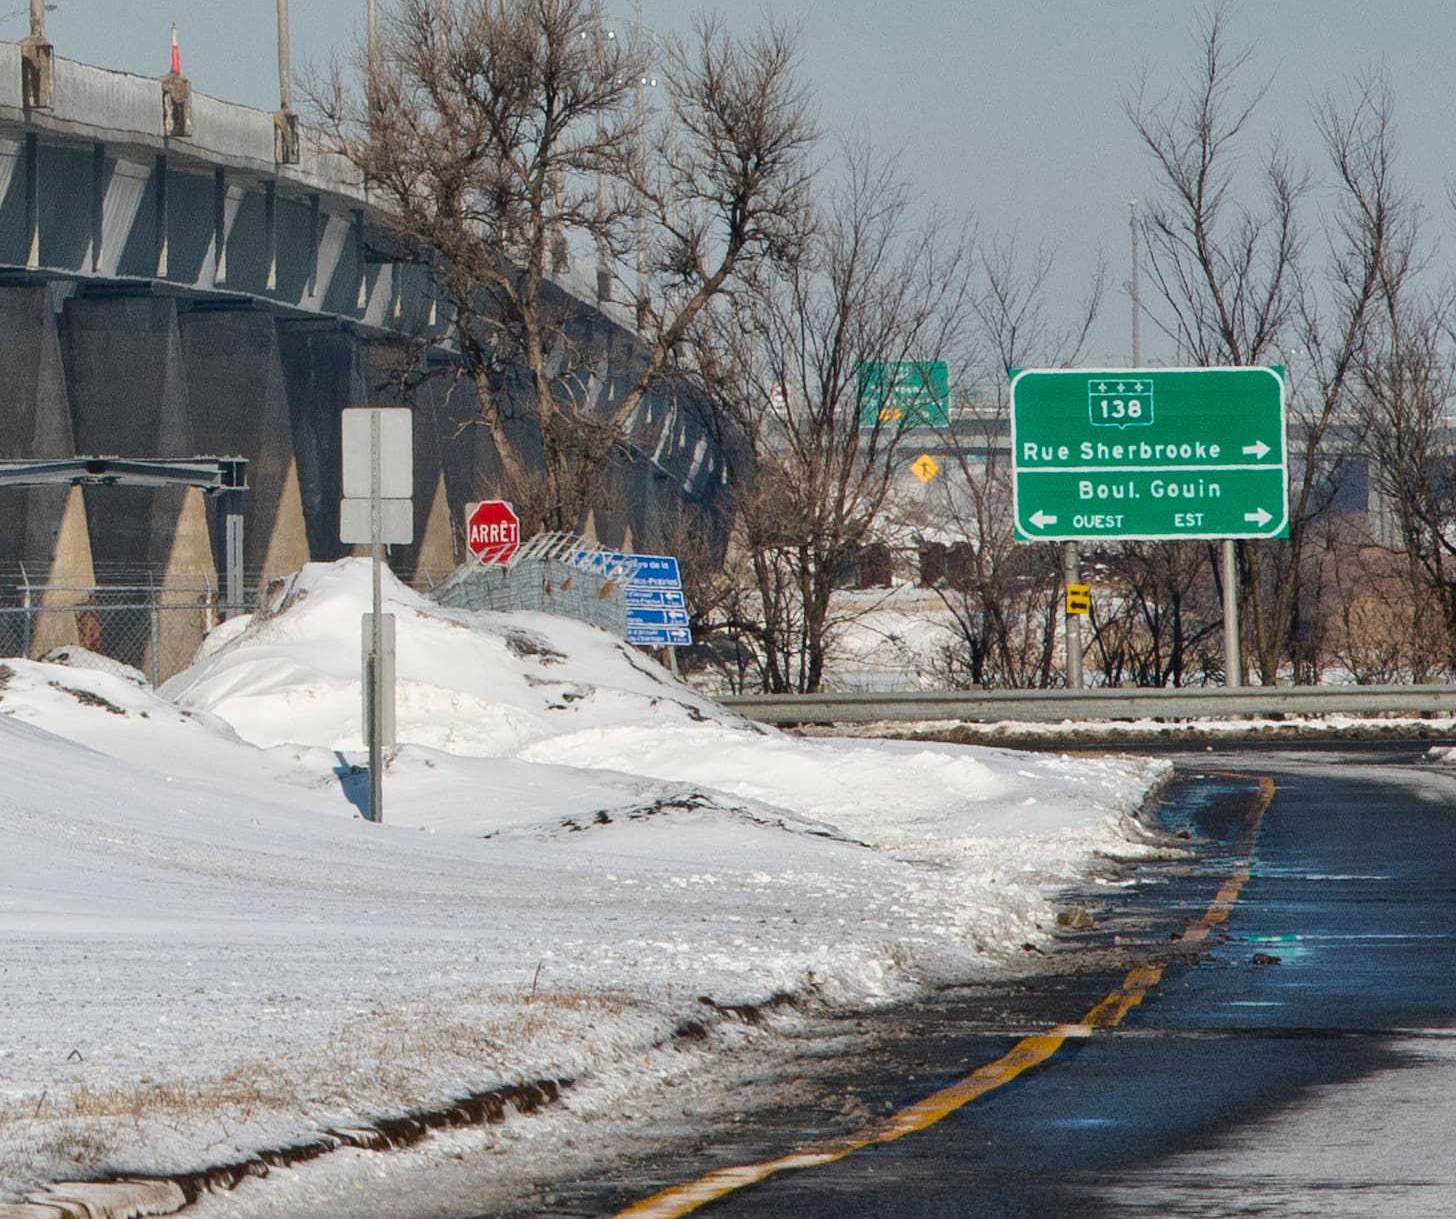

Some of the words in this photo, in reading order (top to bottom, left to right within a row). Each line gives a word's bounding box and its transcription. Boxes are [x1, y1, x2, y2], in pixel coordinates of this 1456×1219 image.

[1100, 399, 1142, 418] 138
[1023, 442, 1069, 461] Rue
[1080, 441, 1221, 460] Sherbrooke
[1078, 480, 1140, 499] Boul.
[1150, 479, 1221, 498] Gouin
[1072, 514, 1123, 529] OUEST
[1174, 512, 1204, 527] EST
[470, 520, 517, 543] ARRÊT
